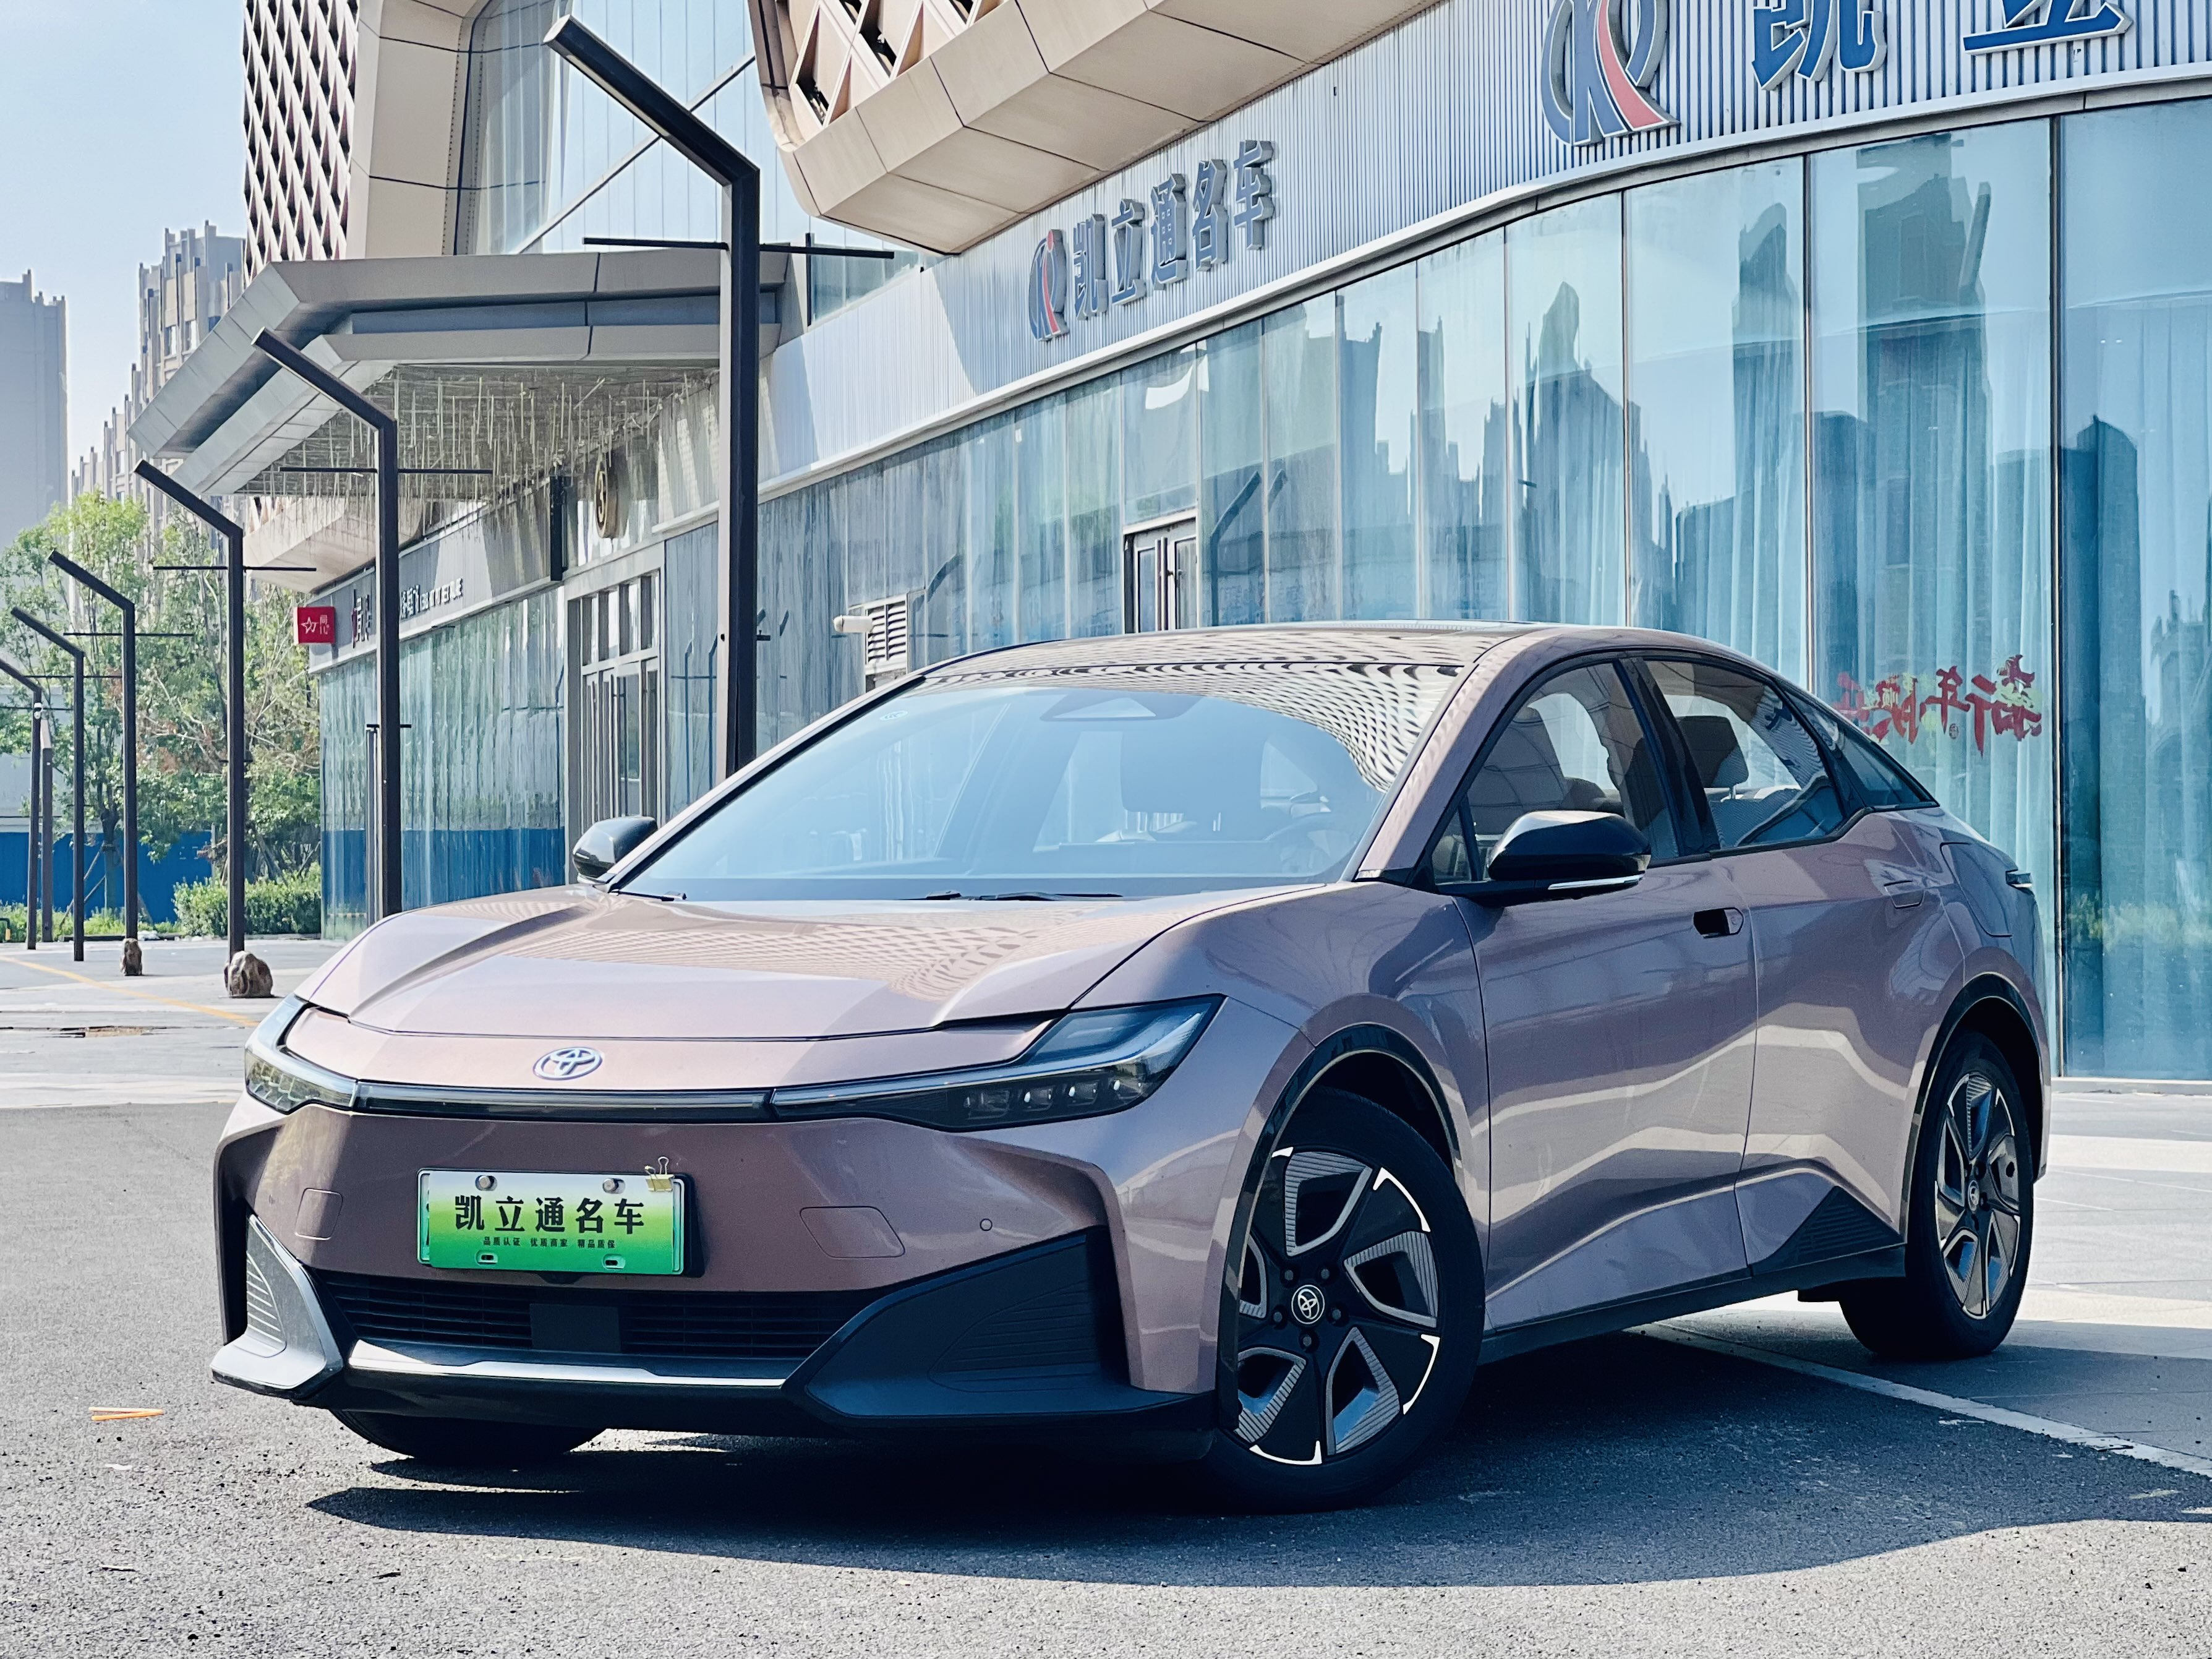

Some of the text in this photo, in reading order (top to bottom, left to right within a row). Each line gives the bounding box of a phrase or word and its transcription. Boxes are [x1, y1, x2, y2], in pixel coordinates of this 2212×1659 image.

[1073, 139, 1275, 320] 凯立通名车
[455, 1195, 644, 1235] 凯立通名车
[483, 1237, 616, 1250] 品质认证 优质商家 精品质保
